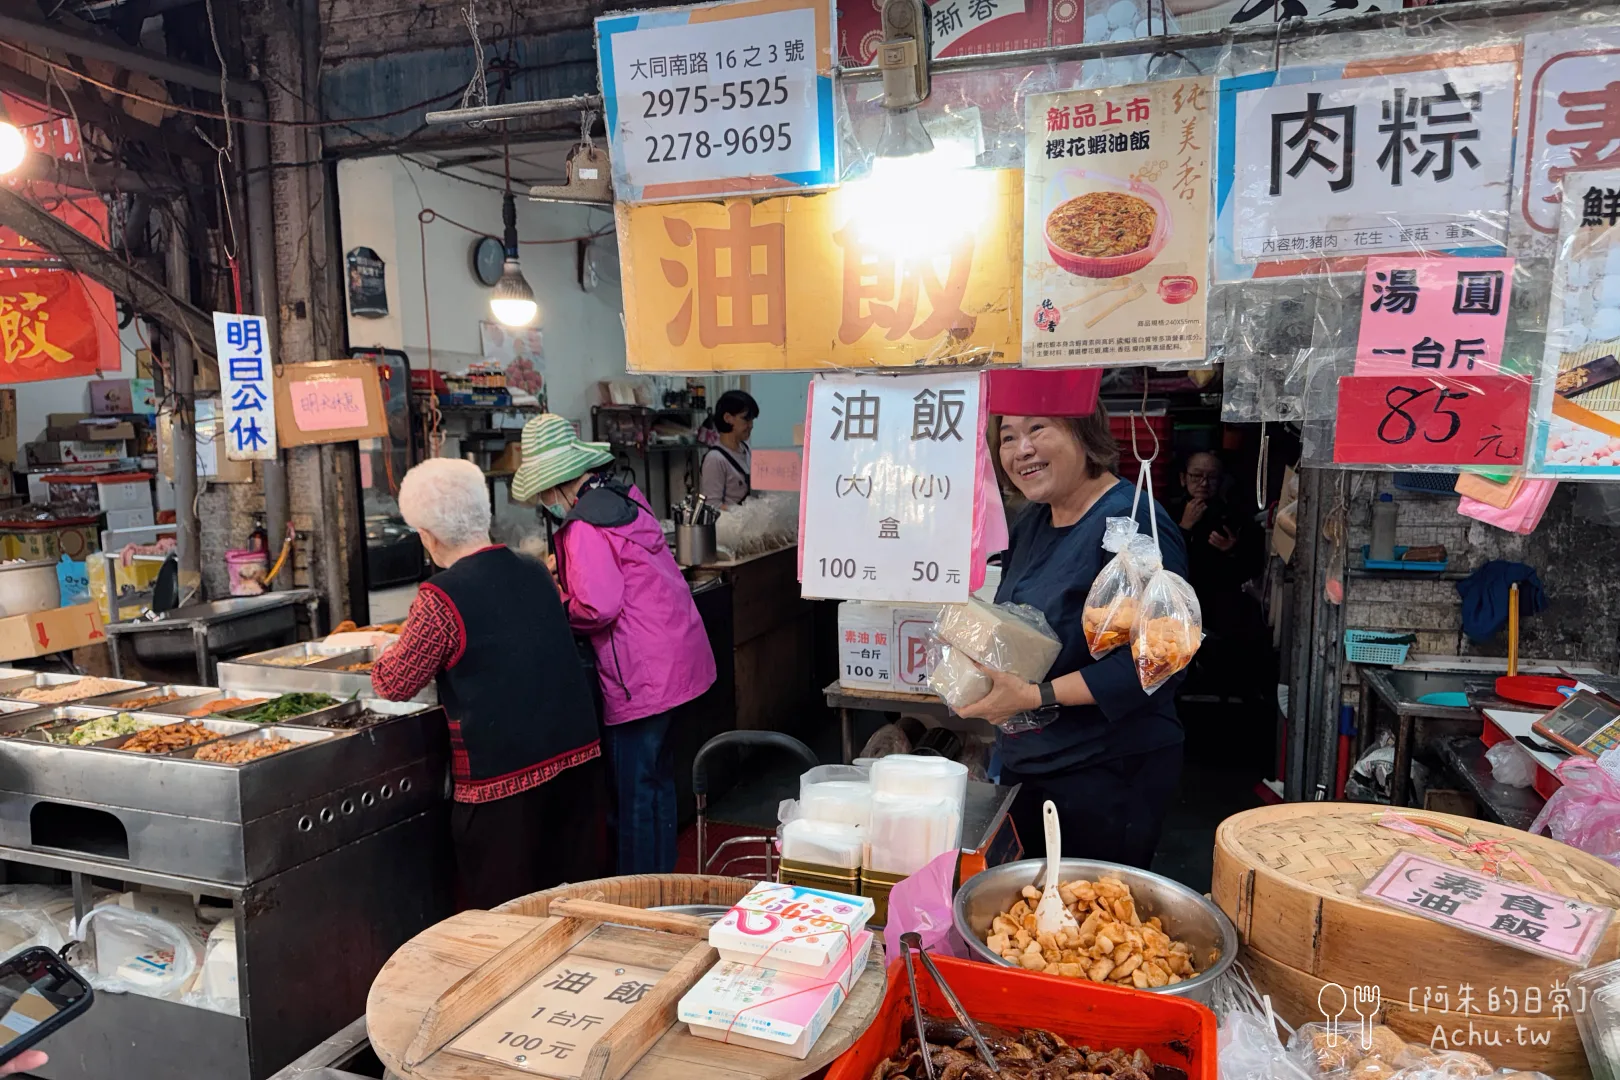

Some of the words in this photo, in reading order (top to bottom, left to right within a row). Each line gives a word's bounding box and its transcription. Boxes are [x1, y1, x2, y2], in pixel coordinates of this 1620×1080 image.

[630, 52, 708, 80] 大同南路
[715, 50, 737, 70] 16
[743, 46, 762, 68] 之
[768, 45, 778, 64] 3
[785, 39, 805, 62] 號
[642, 75, 788, 118] 2975-5525
[1047, 98, 1151, 131] 新品上市
[645, 123, 792, 163] 2278-9695
[1046, 130, 1150, 159] 櫻花蝦油飯
[1269, 82, 1483, 196] 肉粽
[660, 202, 978, 349] 油飯
[1370, 269, 1505, 316] 湯圓
[1372, 337, 1486, 370] 一台斤
[227, 320, 267, 451] 明日公休
[830, 388, 965, 443] 油飯
[1377, 385, 1469, 445] 85
[1474, 425, 1518, 458] 元
[878, 517, 900, 539] 盒
[819, 557, 856, 579] 100
[862, 566, 877, 580] 元
[912, 561, 940, 582] 50
[946, 569, 960, 584] 元
[845, 630, 887, 646] 素油飯
[850, 648, 881, 660] 一台斤
[846, 665, 873, 677] 100
[879, 669, 889, 680] 元
[1407, 887, 1550, 943] 油飯
[543, 969, 655, 1005] 油飯
[530, 1007, 546, 1019] 1
[547, 1010, 604, 1031] 台斤
[497, 1032, 544, 1051] 100
[541, 1041, 576, 1060] 元
